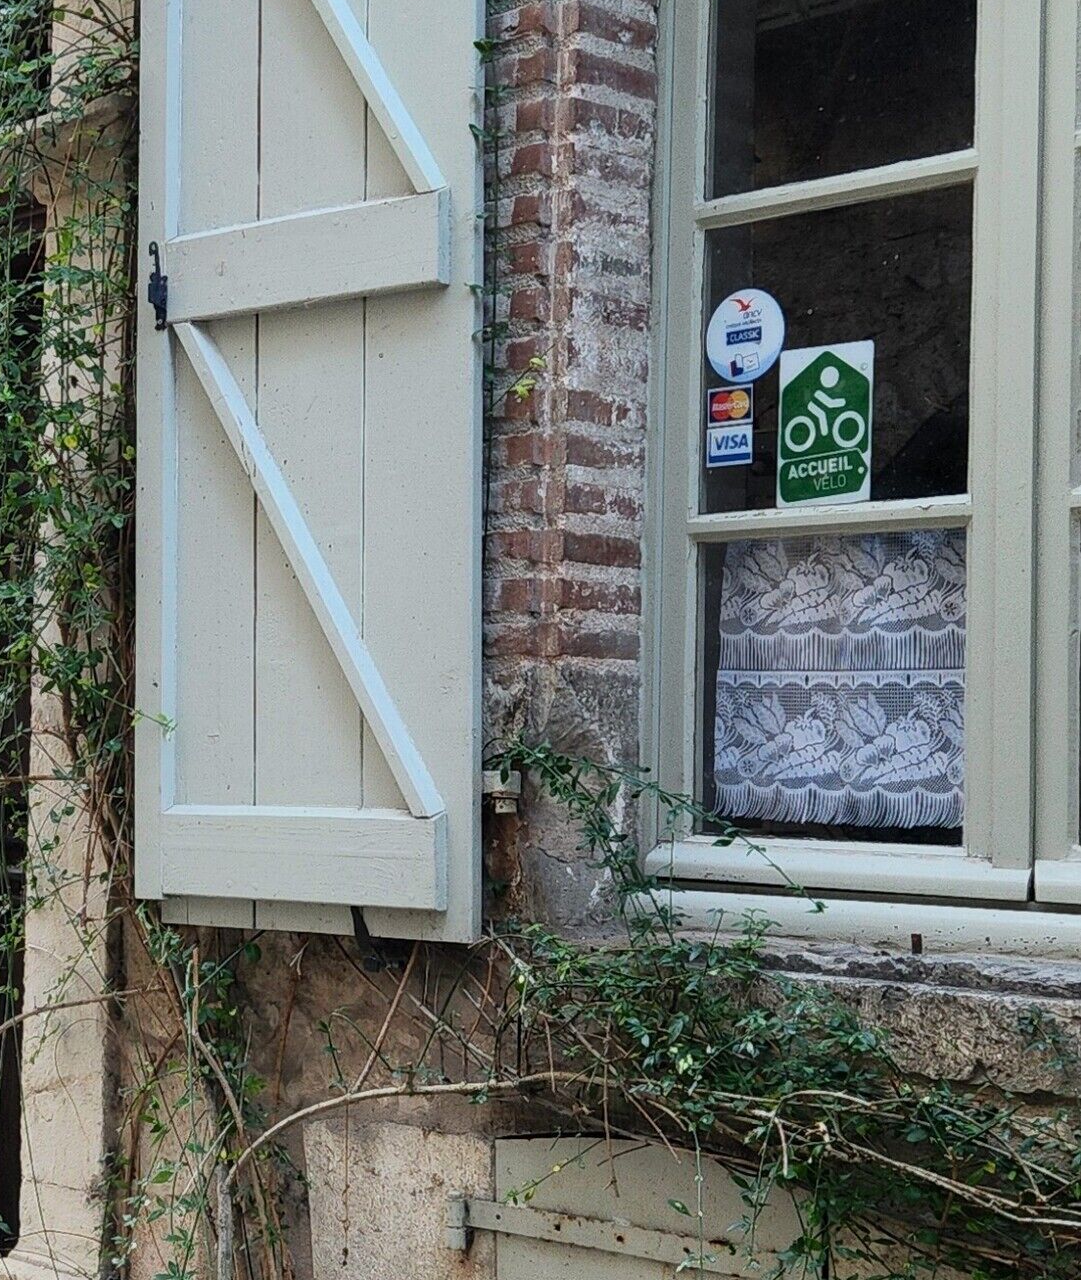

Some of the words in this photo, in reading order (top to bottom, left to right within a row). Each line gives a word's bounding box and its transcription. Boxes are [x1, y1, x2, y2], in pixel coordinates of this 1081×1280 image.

[729, 329, 760, 342] CLASSIC
[714, 433, 749, 451] VISA
[788, 455, 853, 480] ACCUEIL
[813, 473, 847, 491] VÉLO
